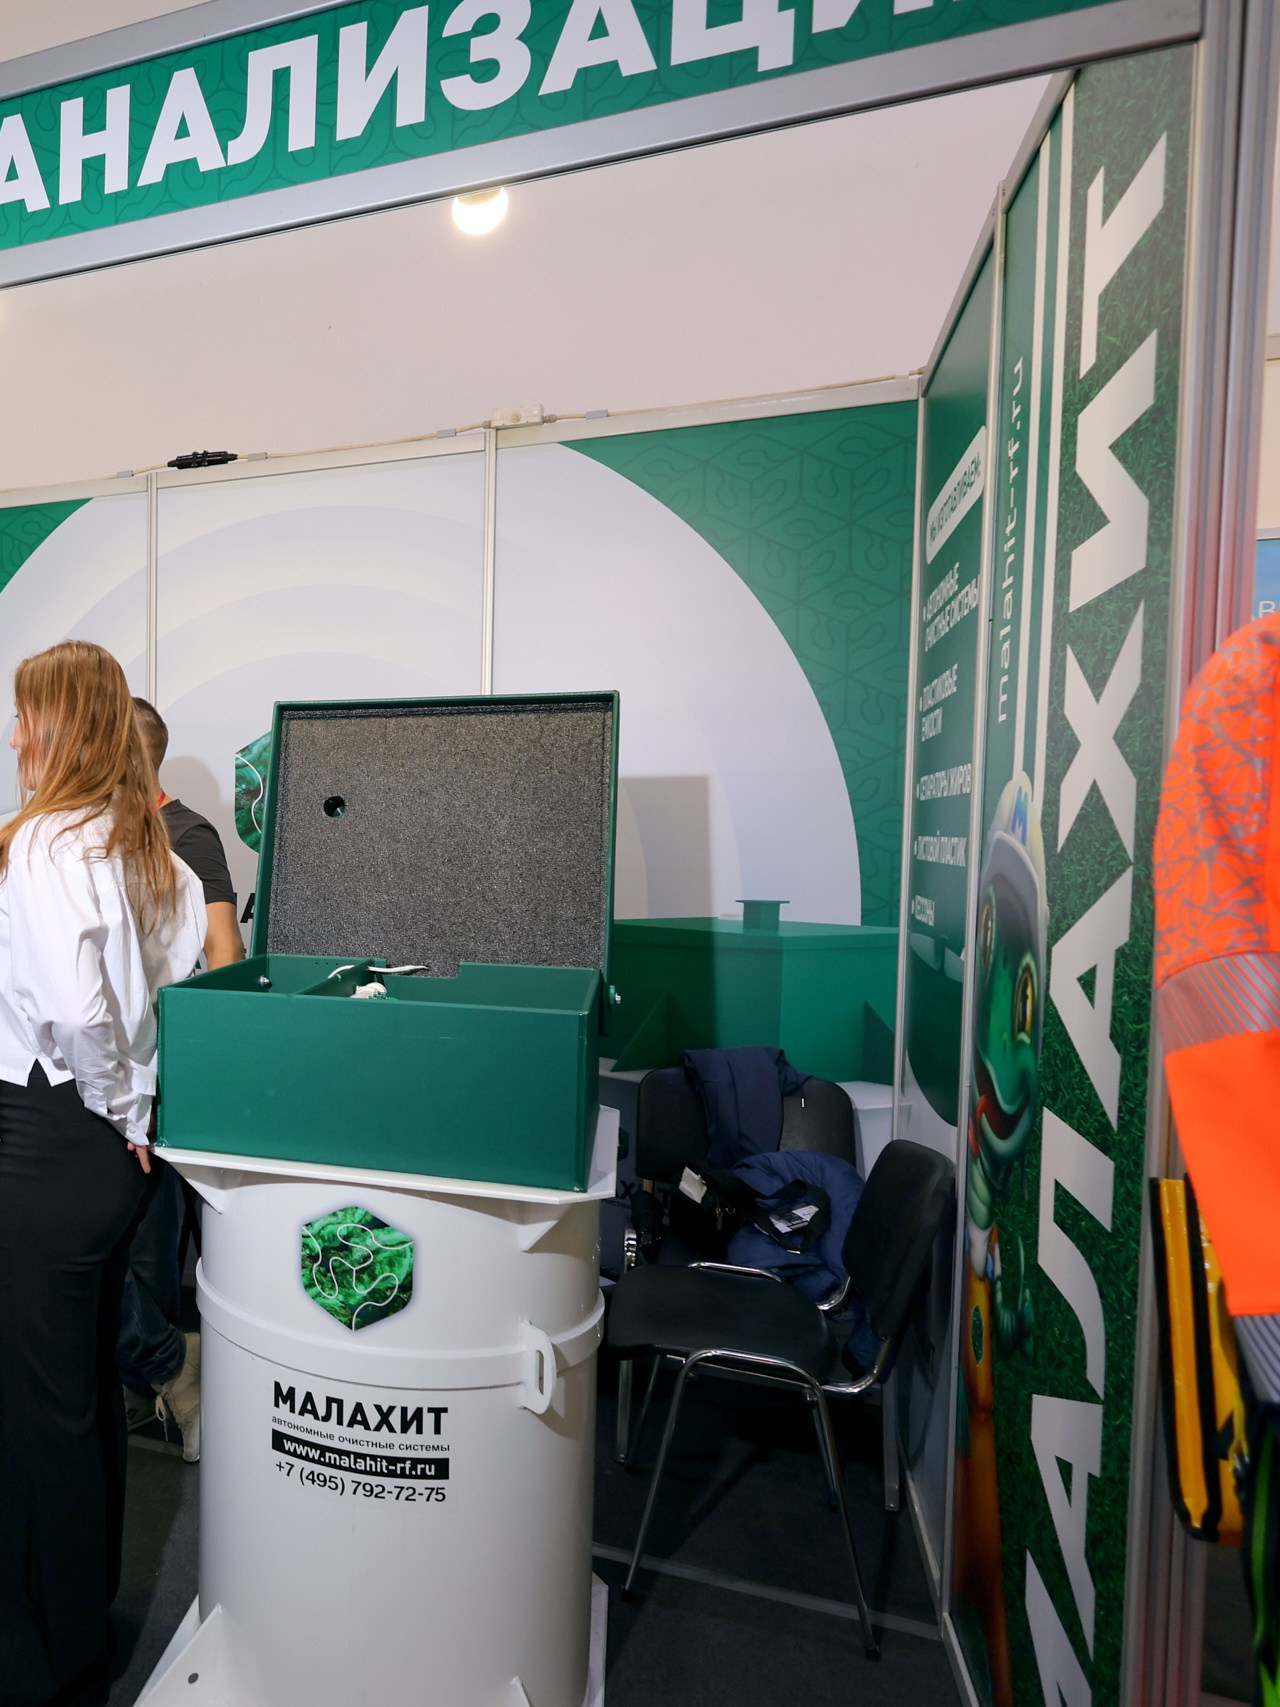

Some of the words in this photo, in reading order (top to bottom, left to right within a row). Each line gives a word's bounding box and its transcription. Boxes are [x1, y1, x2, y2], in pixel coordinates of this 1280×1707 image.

[998, 357, 1024, 723] malahit-rf.ru
[273, 1380, 449, 1435] МАЛАХИТ
[271, 1415, 335, 1441] автономные
[338, 1434, 395, 1451] очистные
[398, 1441, 450, 1453] системы
[283, 1438, 436, 1476] www.malahit-rf.ru
[275, 1460, 295, 1477] +7
[299, 1467, 346, 1496] (495)
[350, 1480, 447, 1503] 792-72-75
